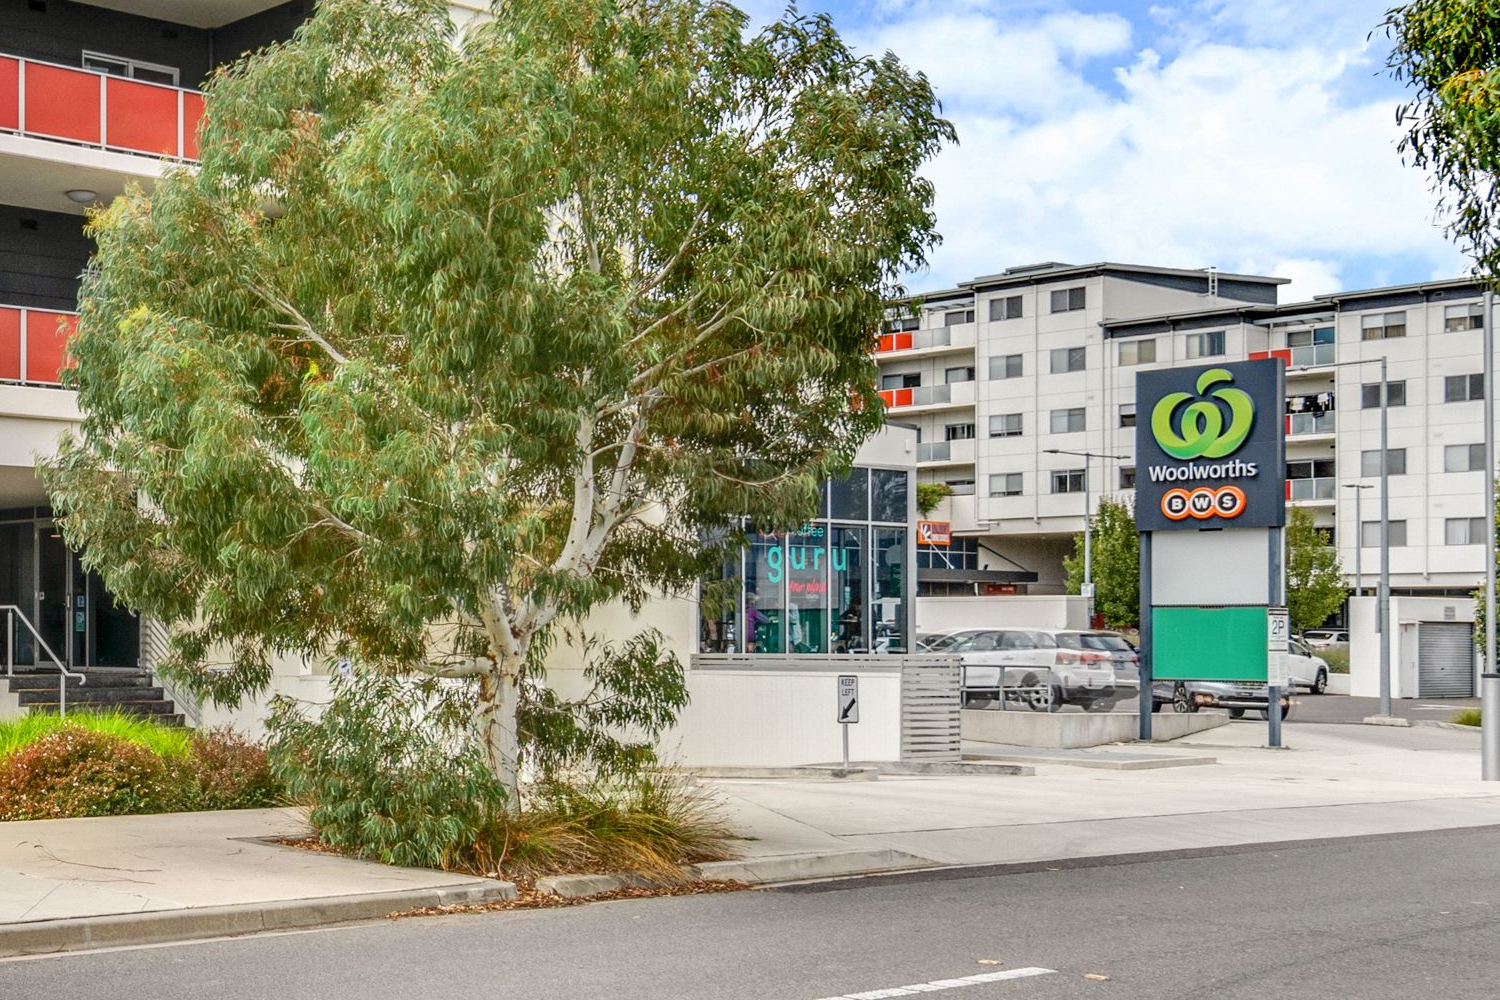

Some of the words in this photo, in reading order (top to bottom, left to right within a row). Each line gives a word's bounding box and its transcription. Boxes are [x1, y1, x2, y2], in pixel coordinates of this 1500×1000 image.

[1148, 459, 1257, 482] Woolworths
[767, 545, 847, 584] guru
[1272, 619, 1285, 635] 2P
[841, 678, 855, 686] KEEP
[841, 688, 855, 696] LEFT
